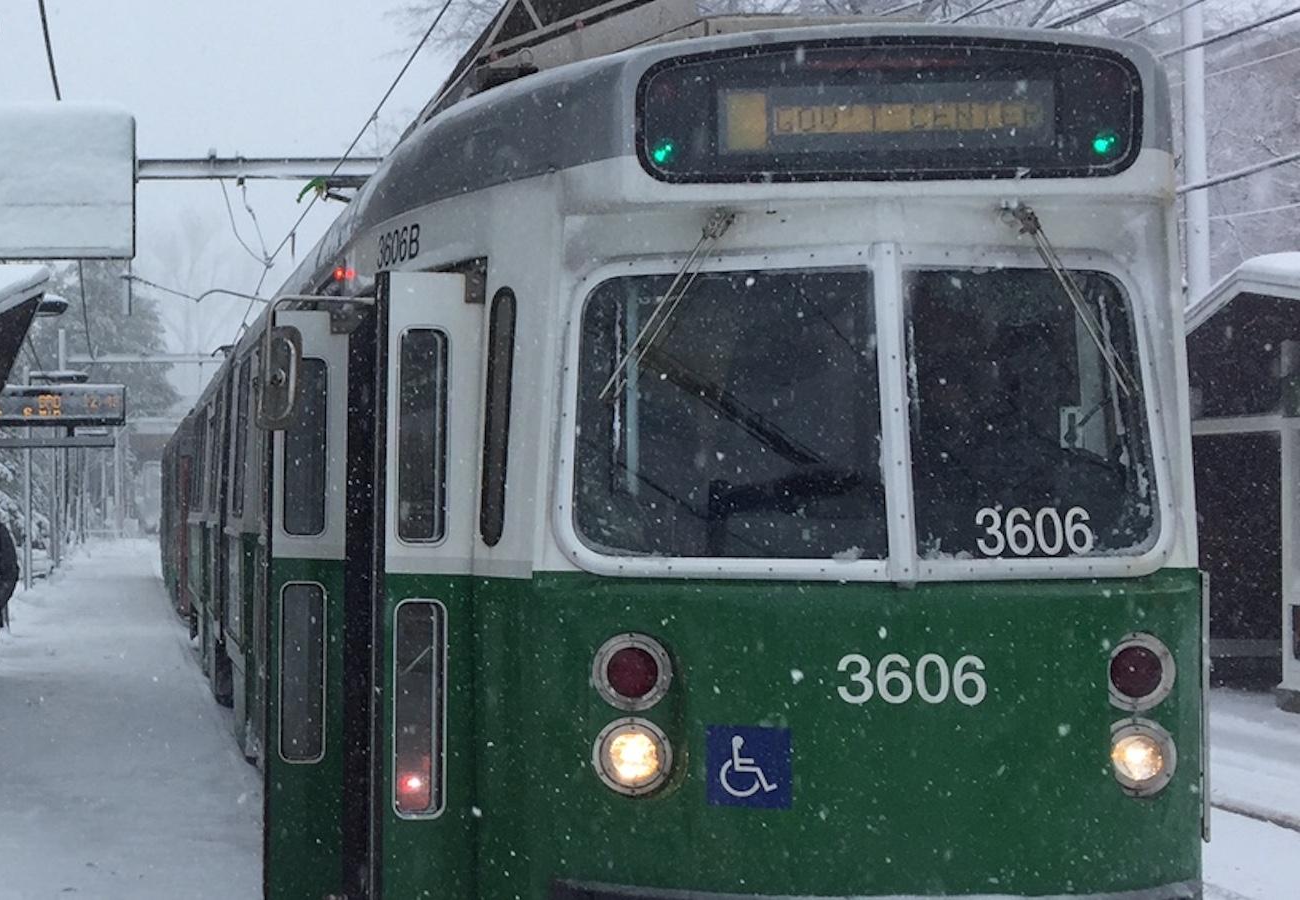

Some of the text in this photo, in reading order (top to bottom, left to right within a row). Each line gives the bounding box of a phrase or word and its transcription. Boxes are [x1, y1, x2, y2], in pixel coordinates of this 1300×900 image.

[909, 103, 1043, 130] CENTER
[377, 223, 420, 269] 3606B
[975, 507, 1094, 556] 3606
[836, 654, 987, 706] 3606
